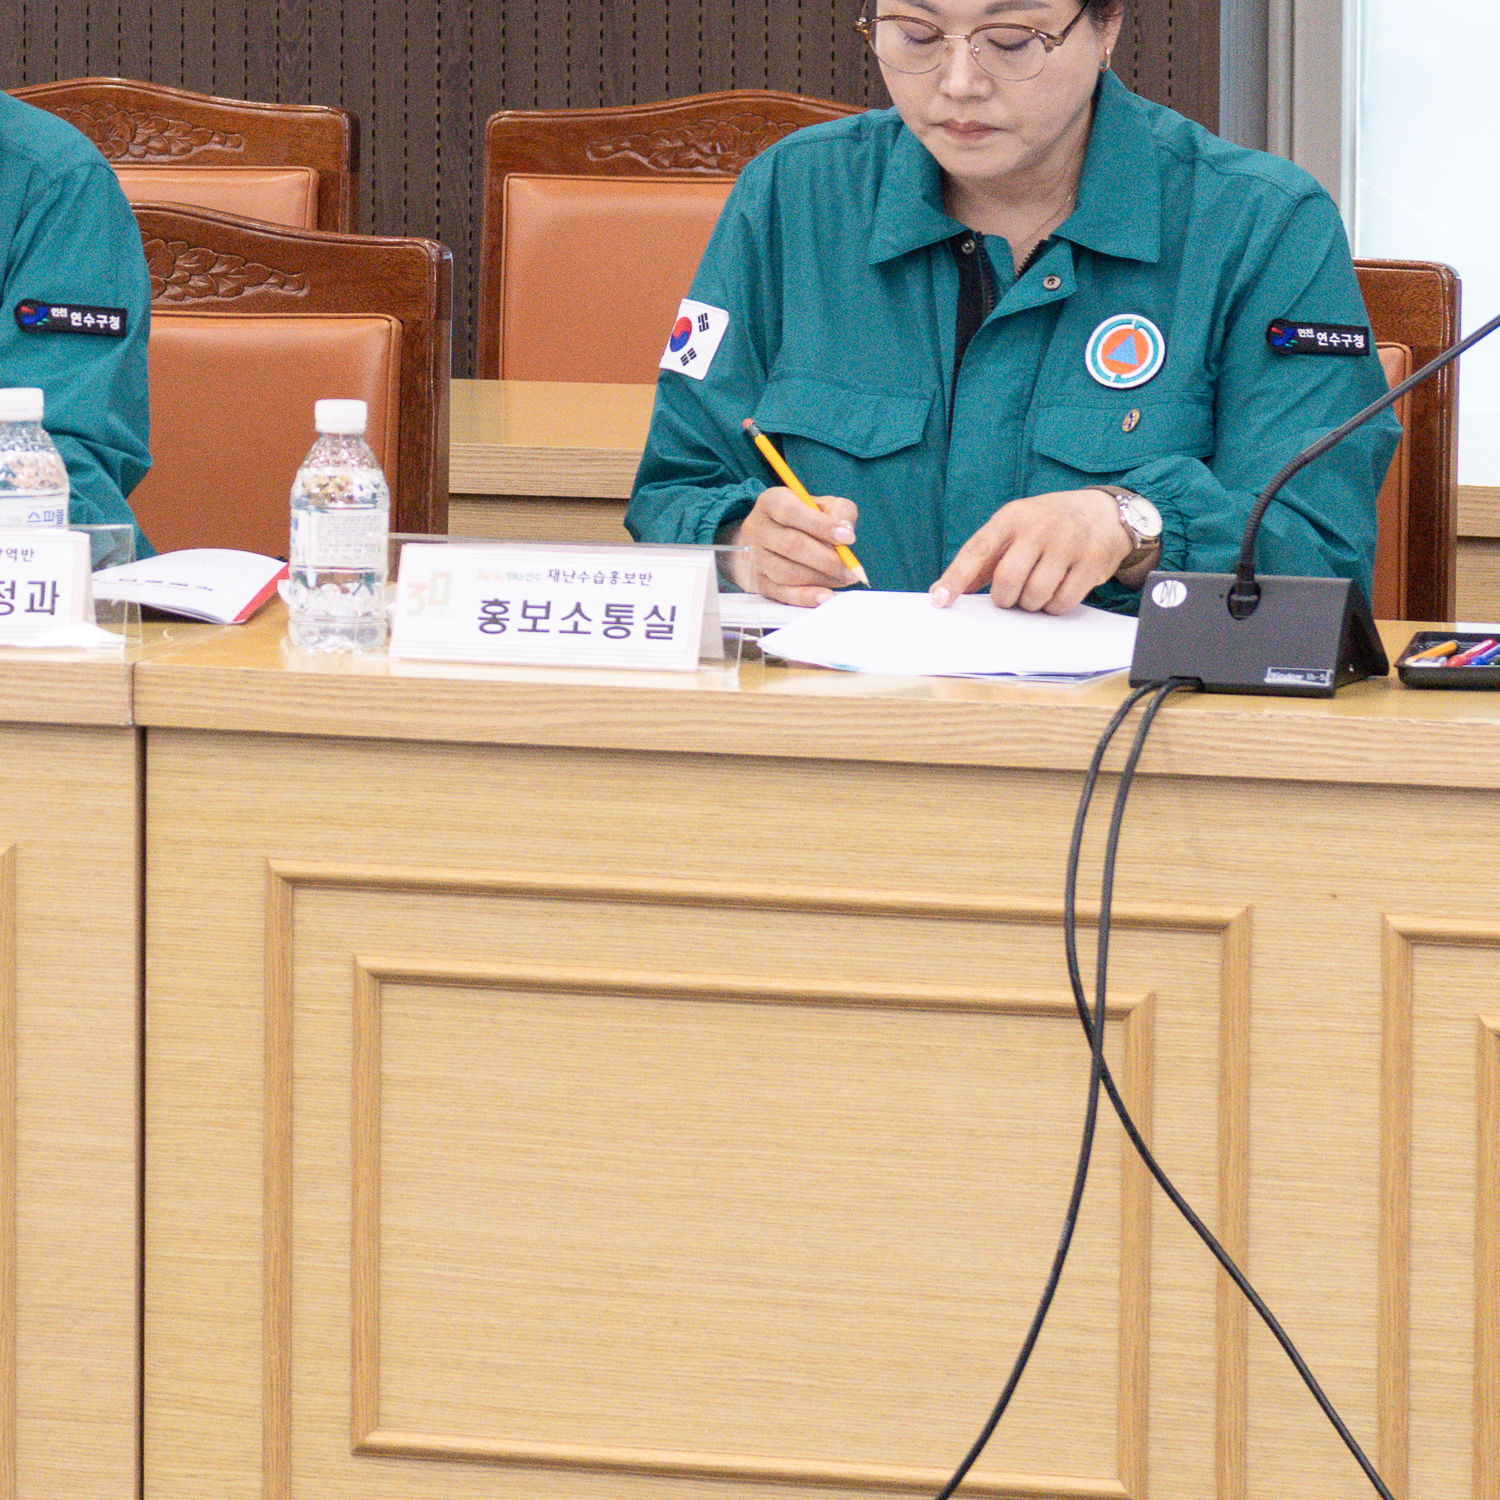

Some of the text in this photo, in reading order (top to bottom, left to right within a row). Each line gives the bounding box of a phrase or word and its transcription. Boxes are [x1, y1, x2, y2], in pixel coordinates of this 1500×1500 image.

[70, 312, 120, 330] 연수구청
[1317, 332, 1365, 348] 연수구청
[26, 509, 64, 525] 스파클
[546, 568, 653, 586] 재난수습홍보반
[478, 598, 676, 640] 홍보소통실
